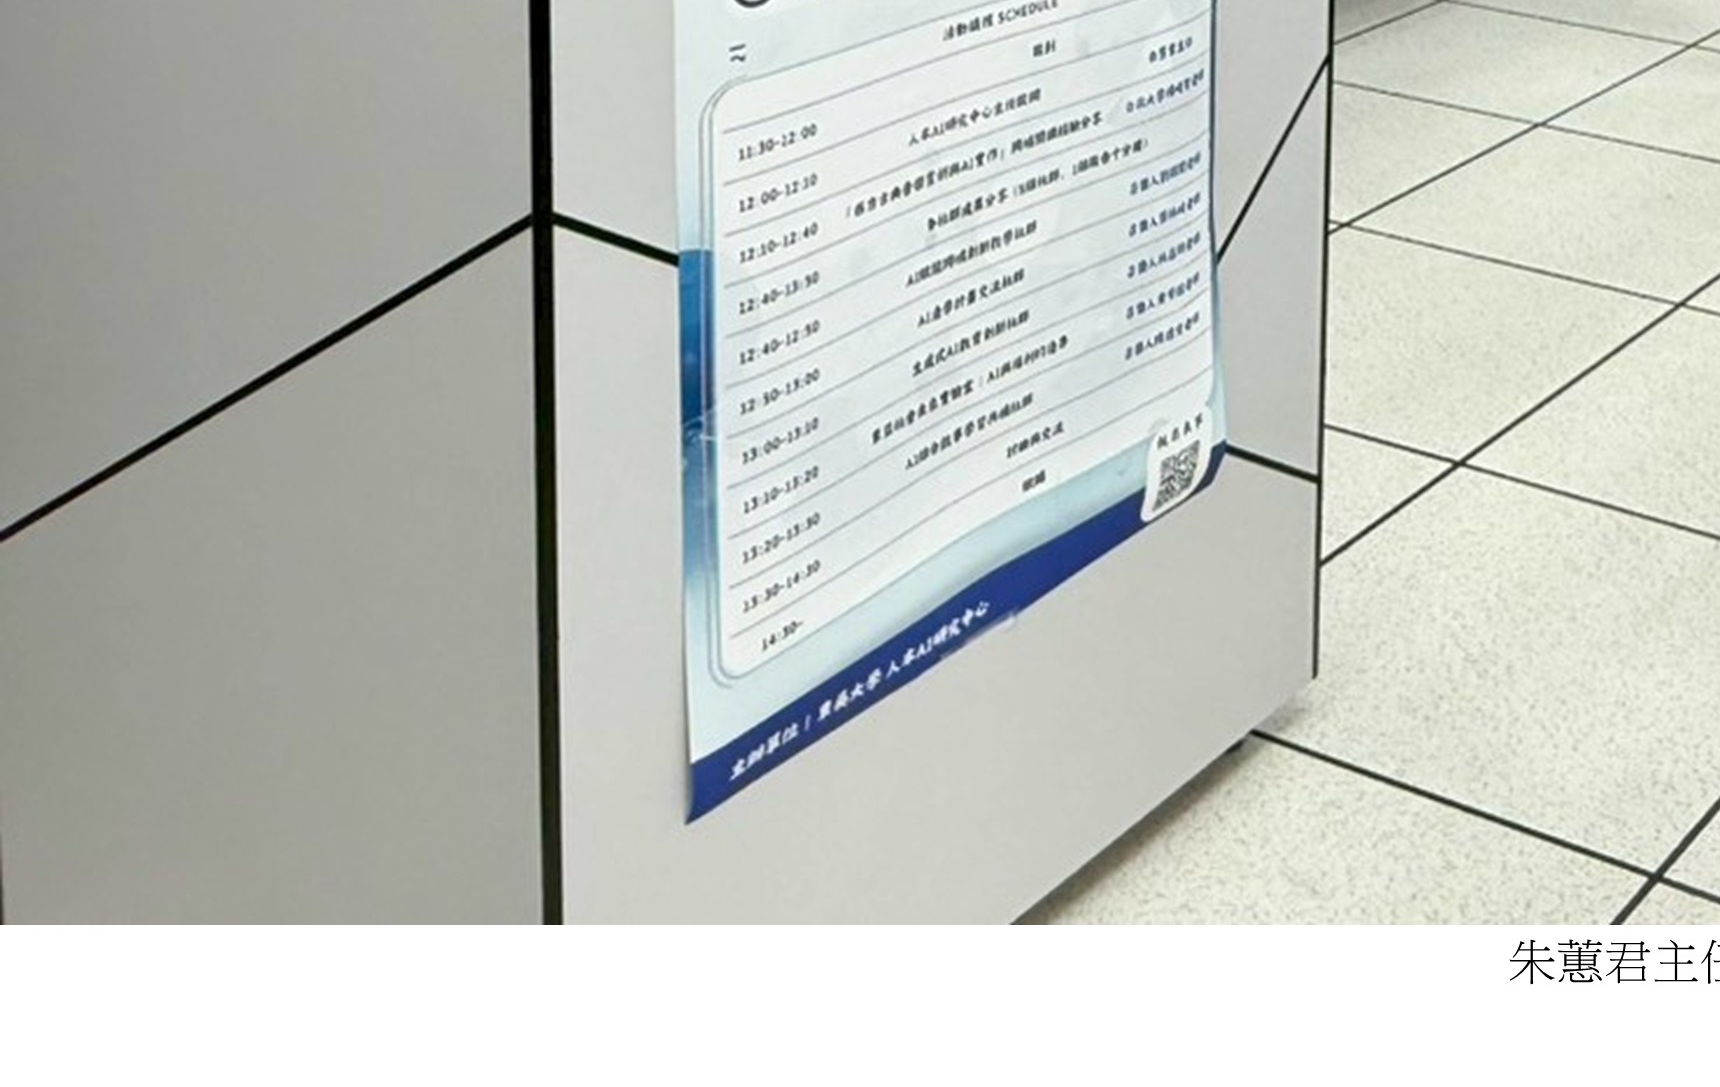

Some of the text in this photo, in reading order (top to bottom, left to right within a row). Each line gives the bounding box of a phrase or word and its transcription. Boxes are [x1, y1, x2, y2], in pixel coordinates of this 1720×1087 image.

[738, 123, 818, 162] 11:30-12:00
[739, 174, 818, 213] 12:00-12:10
[739, 222, 819, 264] 12:10-12:40
[739, 270, 820, 315] 12:40-13:30
[742, 417, 819, 465] 13:00-13:10
[743, 465, 819, 515] 13:10-13:20
[742, 512, 821, 565] 13:20-13:30
[743, 560, 821, 614] 13:30-14:30
